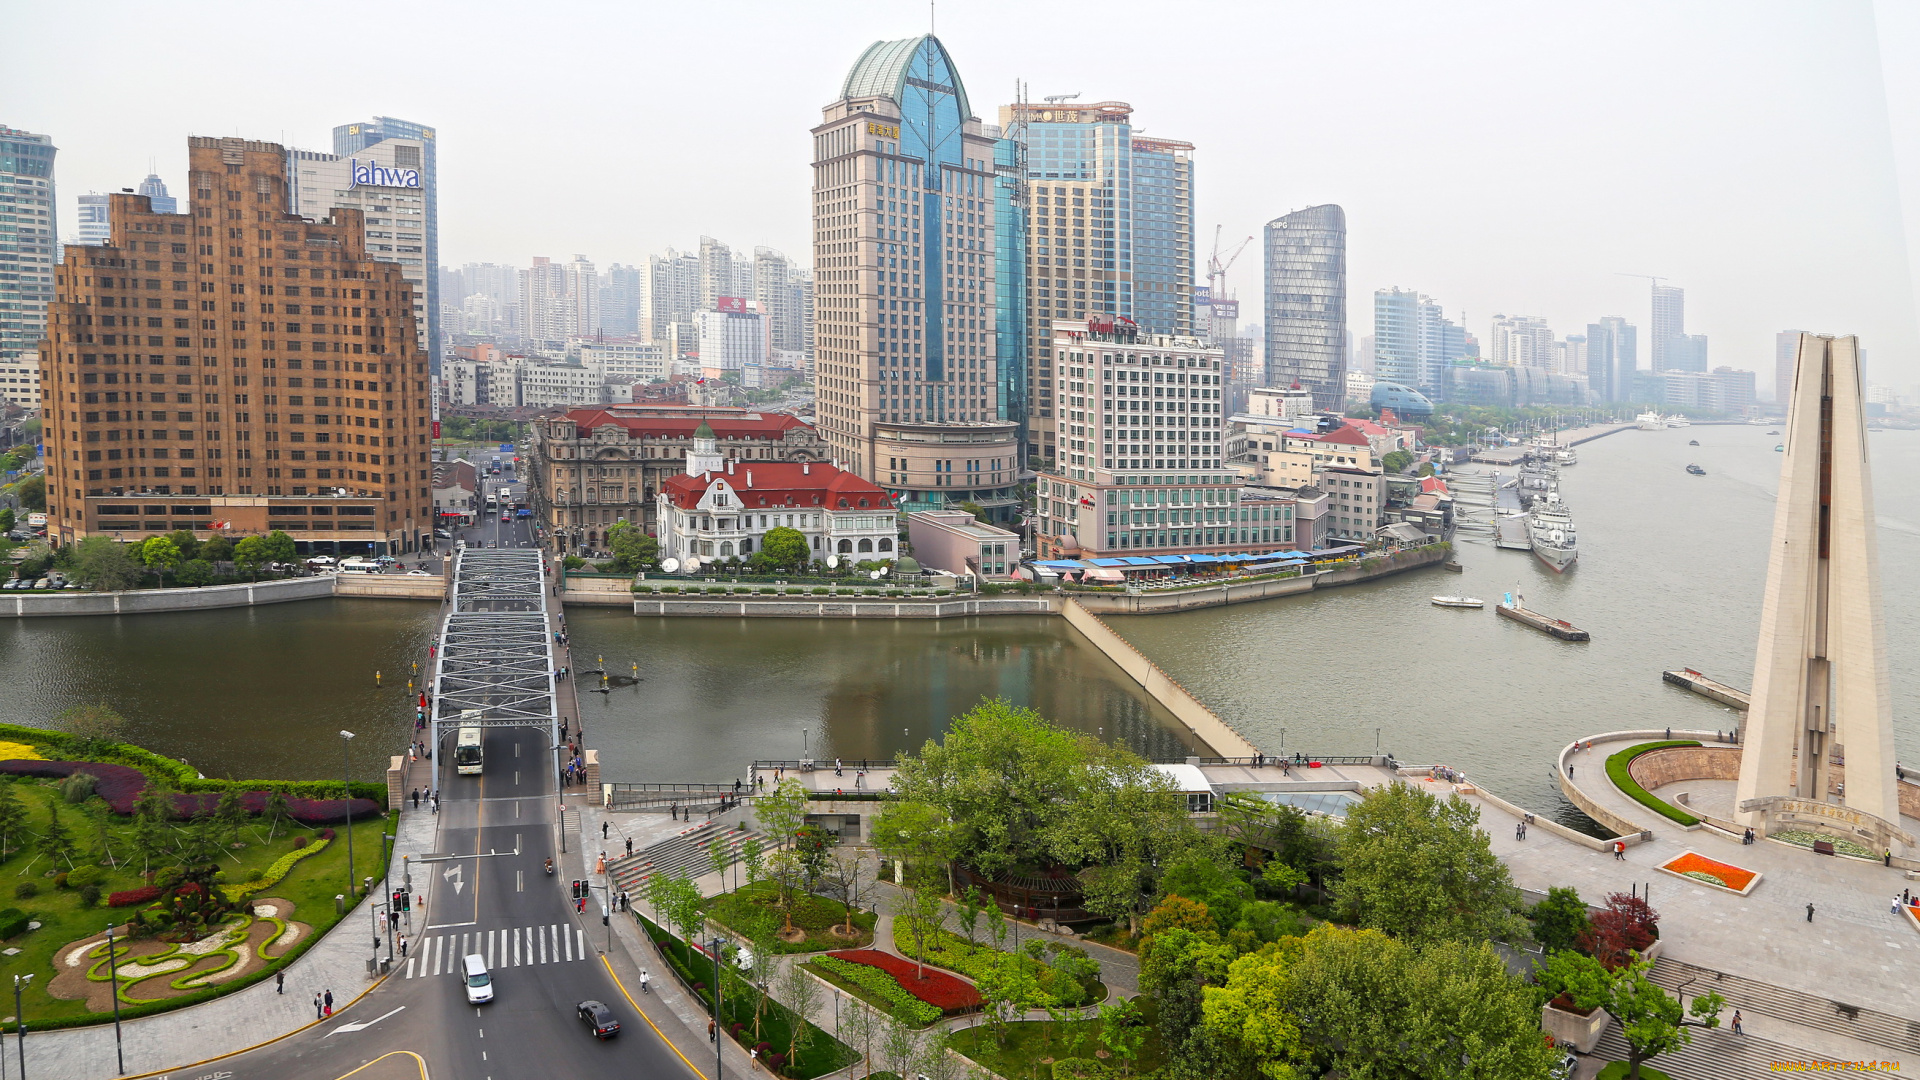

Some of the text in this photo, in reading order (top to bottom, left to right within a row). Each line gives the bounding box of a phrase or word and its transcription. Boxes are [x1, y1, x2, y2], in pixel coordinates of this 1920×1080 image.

[1054, 110, 1078, 123] 世茂
[347, 157, 420, 191] Jahwa
[1272, 221, 1288, 229] SIPG
[1088, 319, 1113, 334] Seagull
